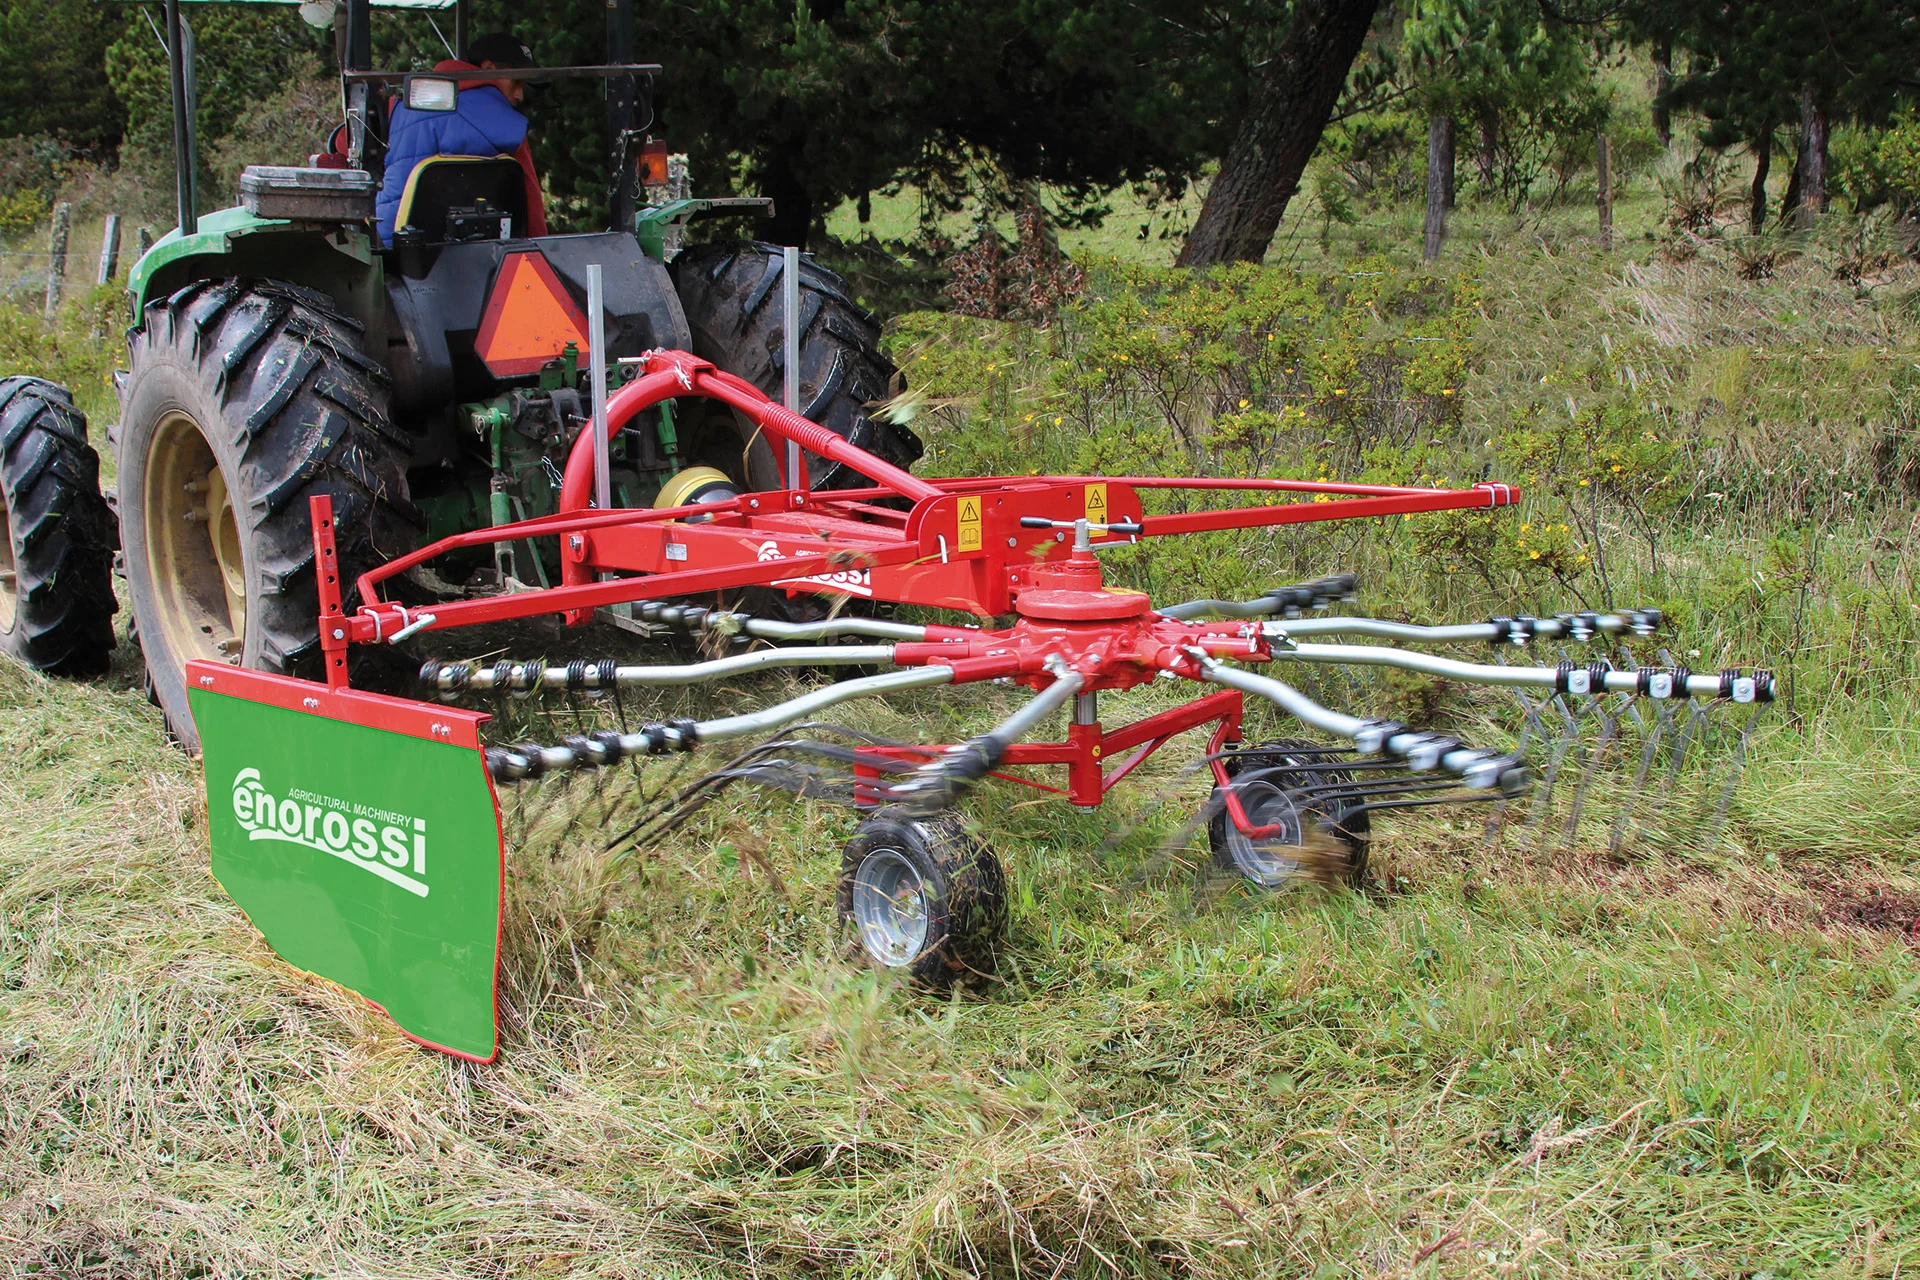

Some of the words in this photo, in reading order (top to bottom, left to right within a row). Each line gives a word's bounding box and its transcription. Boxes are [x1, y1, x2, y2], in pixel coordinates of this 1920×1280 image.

[232, 775, 426, 875] enorossi
[288, 788, 351, 813] AGRICULTURAL
[353, 803, 412, 827] MACHINERY
